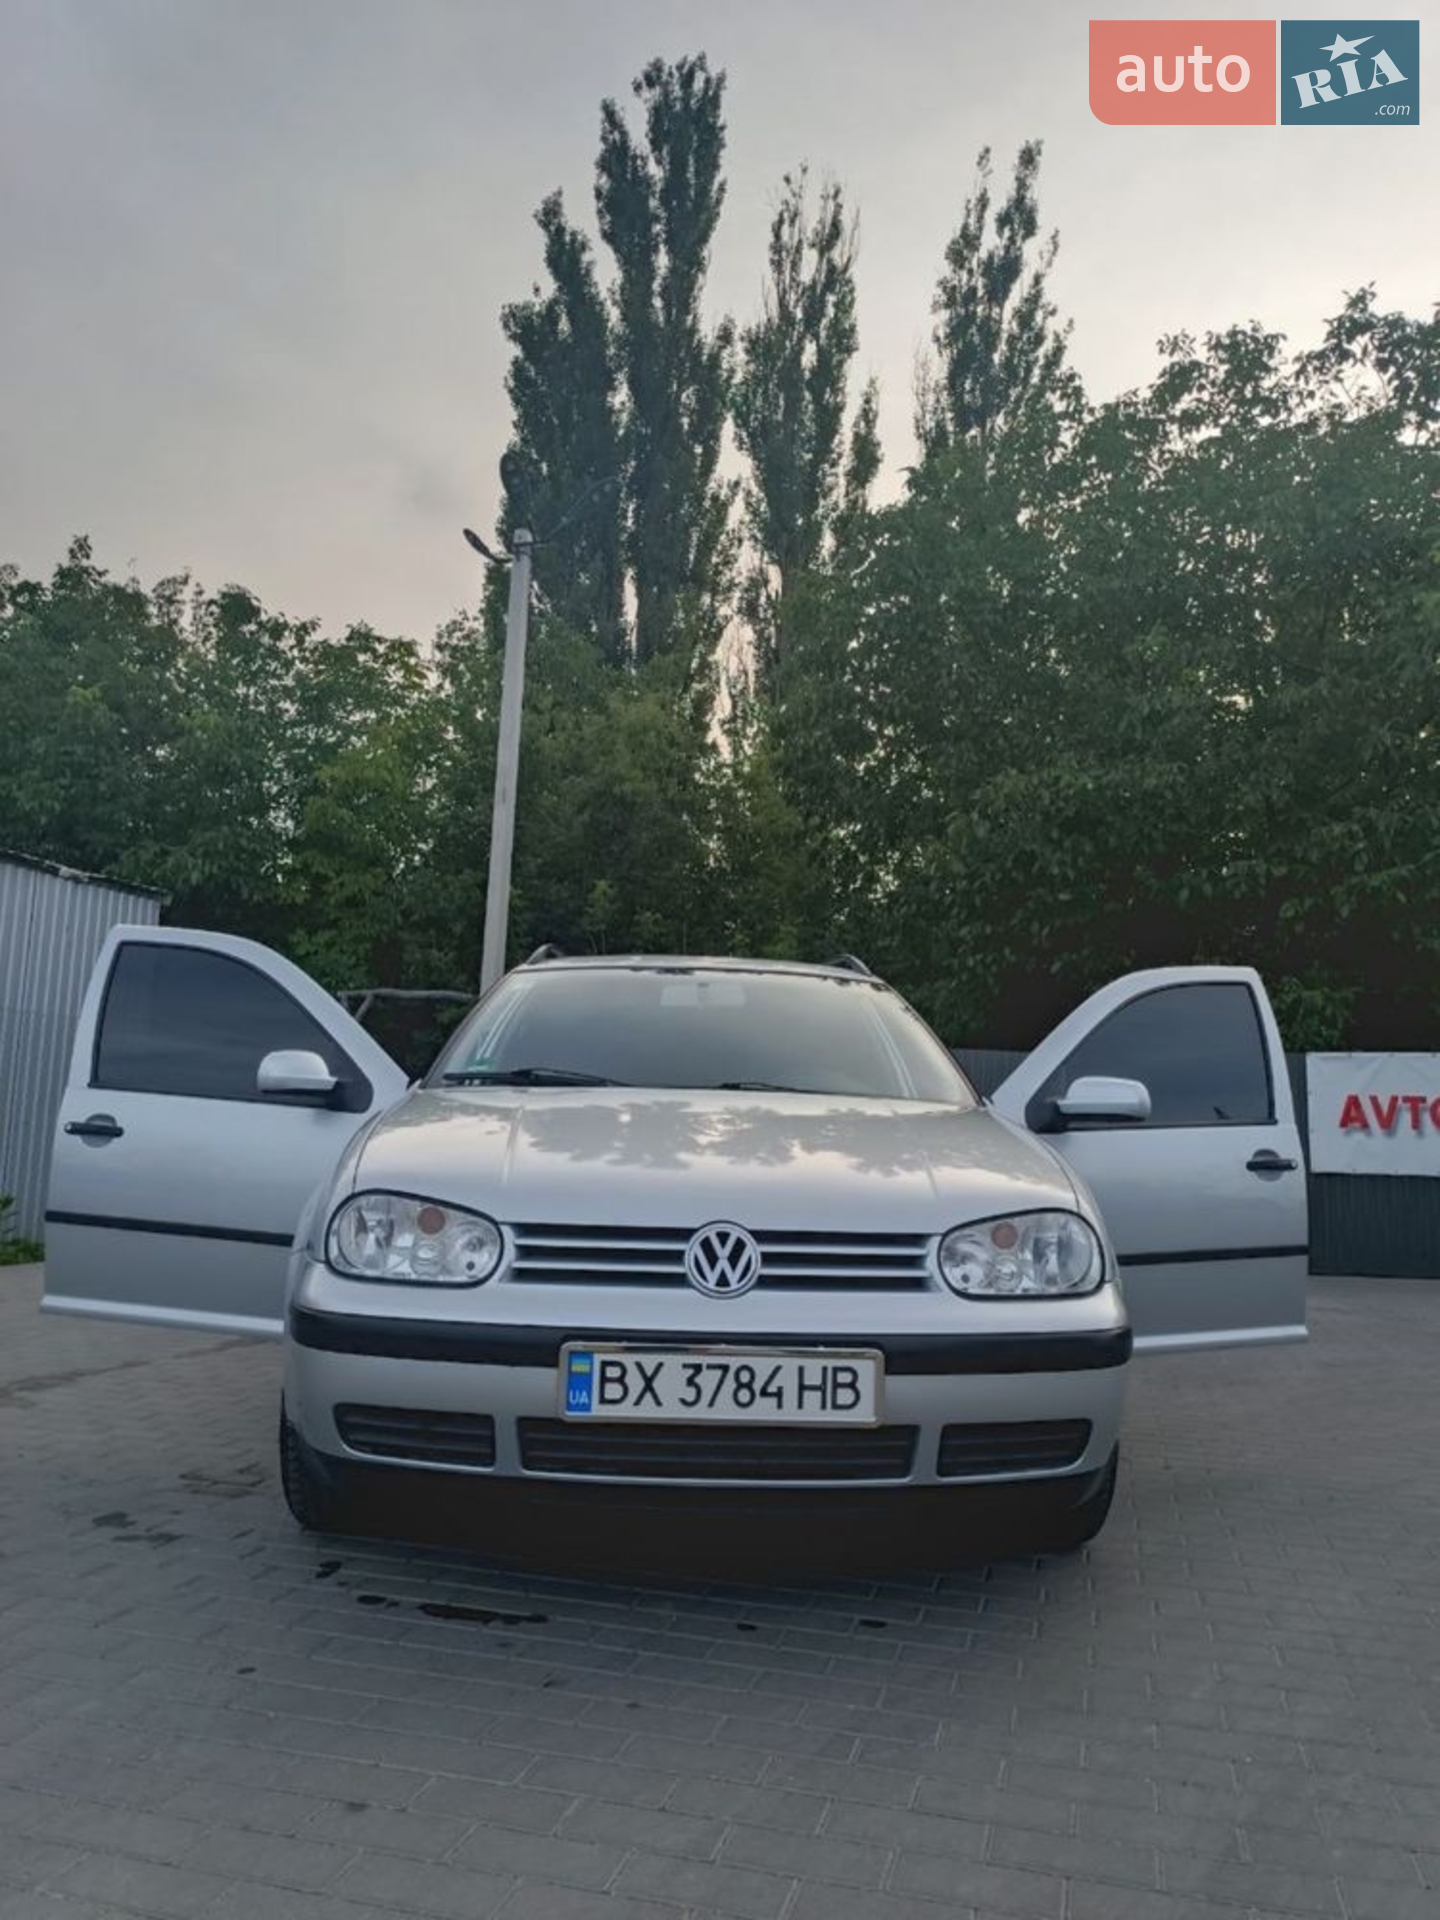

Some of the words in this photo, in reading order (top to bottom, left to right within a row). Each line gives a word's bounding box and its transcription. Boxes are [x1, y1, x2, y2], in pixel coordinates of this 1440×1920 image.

[569, 1389, 589, 1405] UA
[599, 1360, 664, 1407] BX
[679, 1363, 783, 1410] 3784
[798, 1365, 861, 1411] HB
